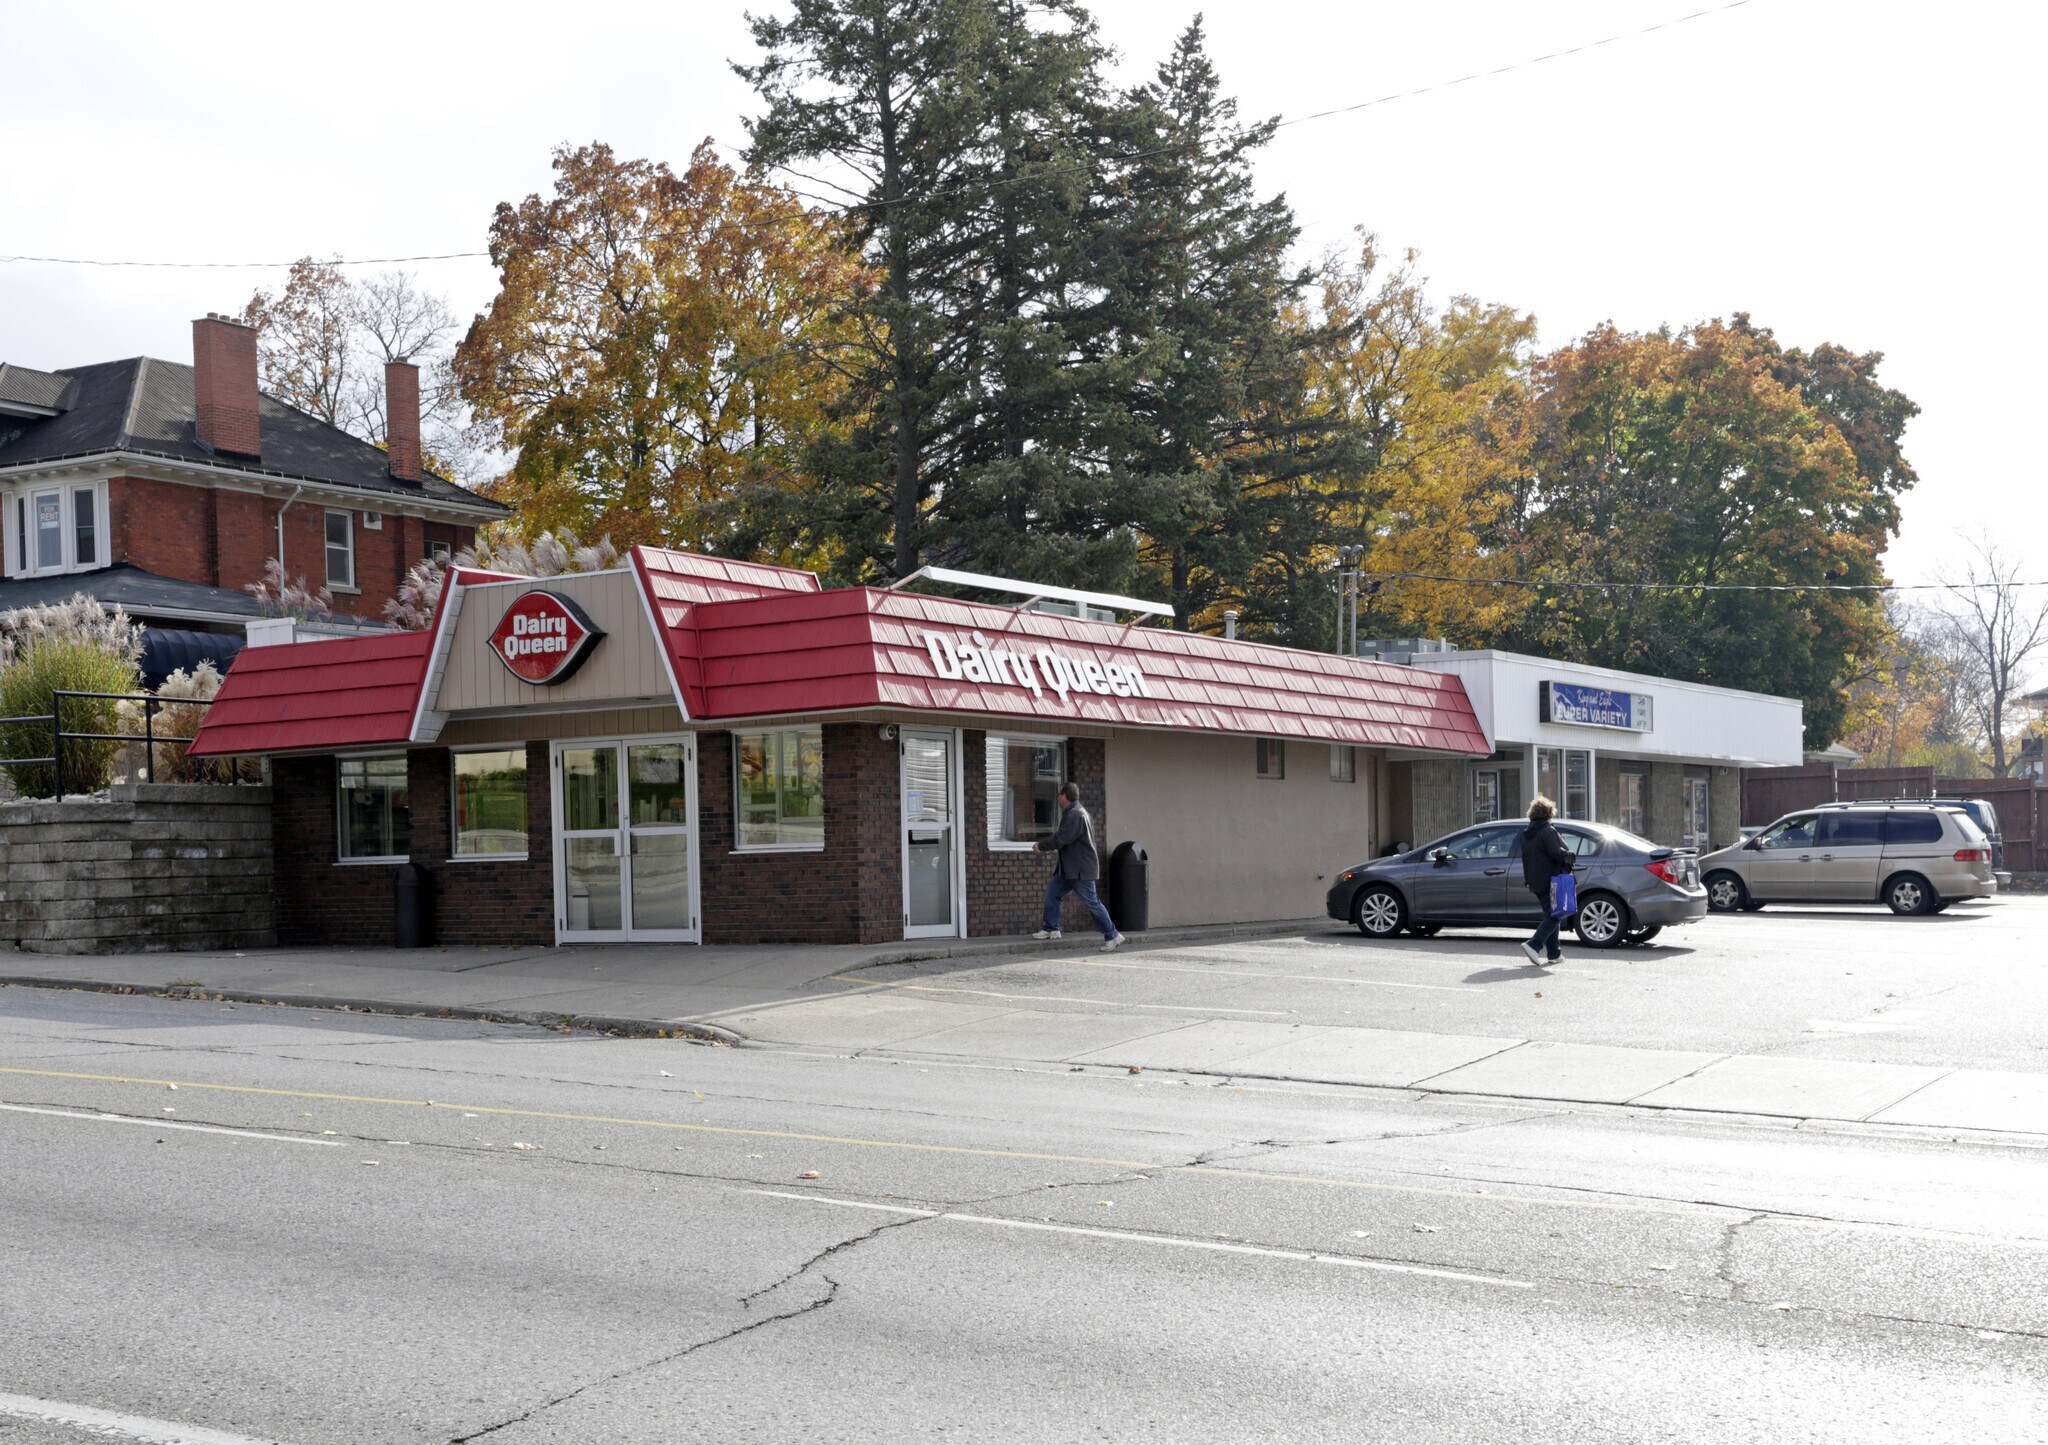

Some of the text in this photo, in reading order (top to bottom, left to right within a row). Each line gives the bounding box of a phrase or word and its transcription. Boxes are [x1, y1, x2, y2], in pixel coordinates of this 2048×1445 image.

[40, 512, 59, 522] RENT
[513, 611, 567, 636] Dairy
[504, 635, 568, 660] Queen
[922, 630, 1152, 702] Dairy Queen
[1556, 705, 1589, 722] SUPER
[1589, 708, 1628, 726] VARIETY
